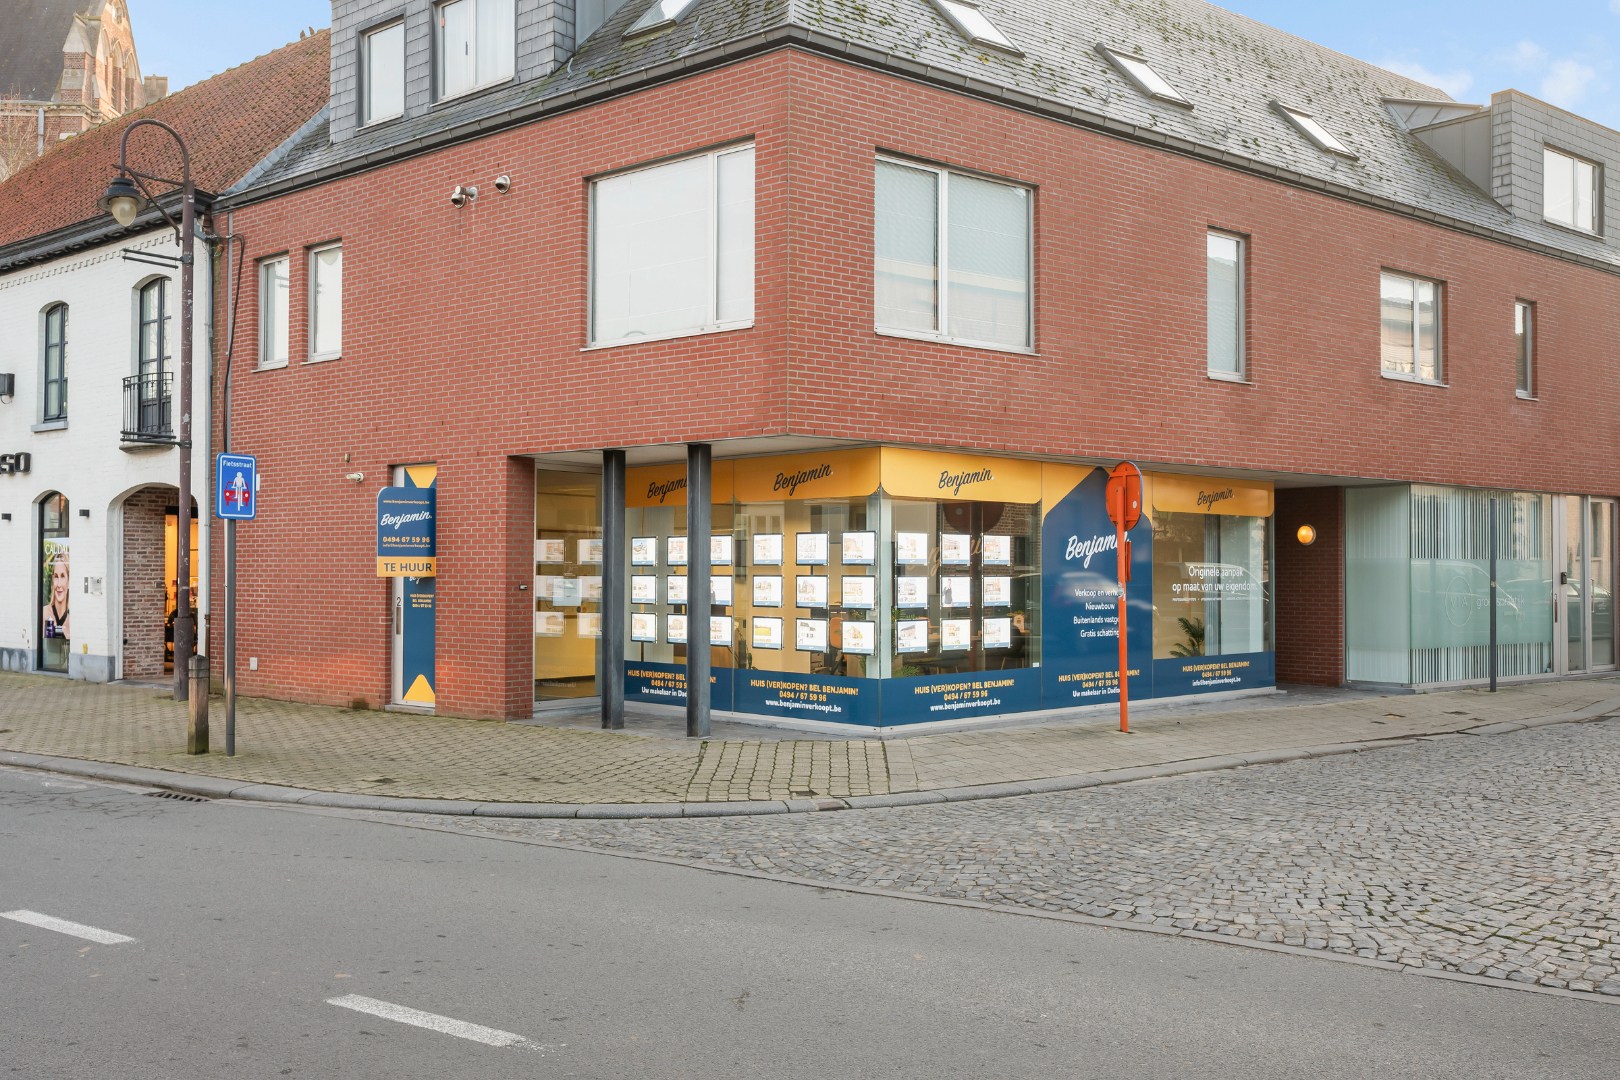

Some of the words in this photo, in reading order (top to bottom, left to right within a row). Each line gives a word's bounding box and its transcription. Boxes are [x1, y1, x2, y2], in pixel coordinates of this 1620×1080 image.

[223, 460, 252, 468] Fietsstraat
[647, 477, 687, 503] Benjami
[384, 563, 396, 572] TE
[400, 563, 432, 572] HUUR
[1189, 566, 1220, 579] Originele
[1221, 567, 1243, 579] aanpak
[1172, 583, 1181, 594] op
[1183, 582, 1200, 591] maat
[1074, 589, 1096, 598] Verkoop
[1086, 602, 1115, 610] Nieuwbouw
[1074, 616, 1103, 624] Buitenlands
[1081, 629, 1096, 637] Gratis
[641, 670, 675, 679] (VER)KOPEN?
[1072, 672, 1104, 681] (VER)KOPEN?
[766, 680, 808, 691] (VER)KOPEN?
[823, 686, 858, 695] BENJAMIN!
[931, 683, 970, 694] (VER)KOPEN?
[984, 679, 1014, 688] BENJAMIN!
[650, 687, 672, 696] makelaar
[779, 690, 794, 699] 0494
[766, 699, 842, 713] www.benjaminverkoopt.be
[930, 698, 1001, 712] www.benjaminverkoopt.be
